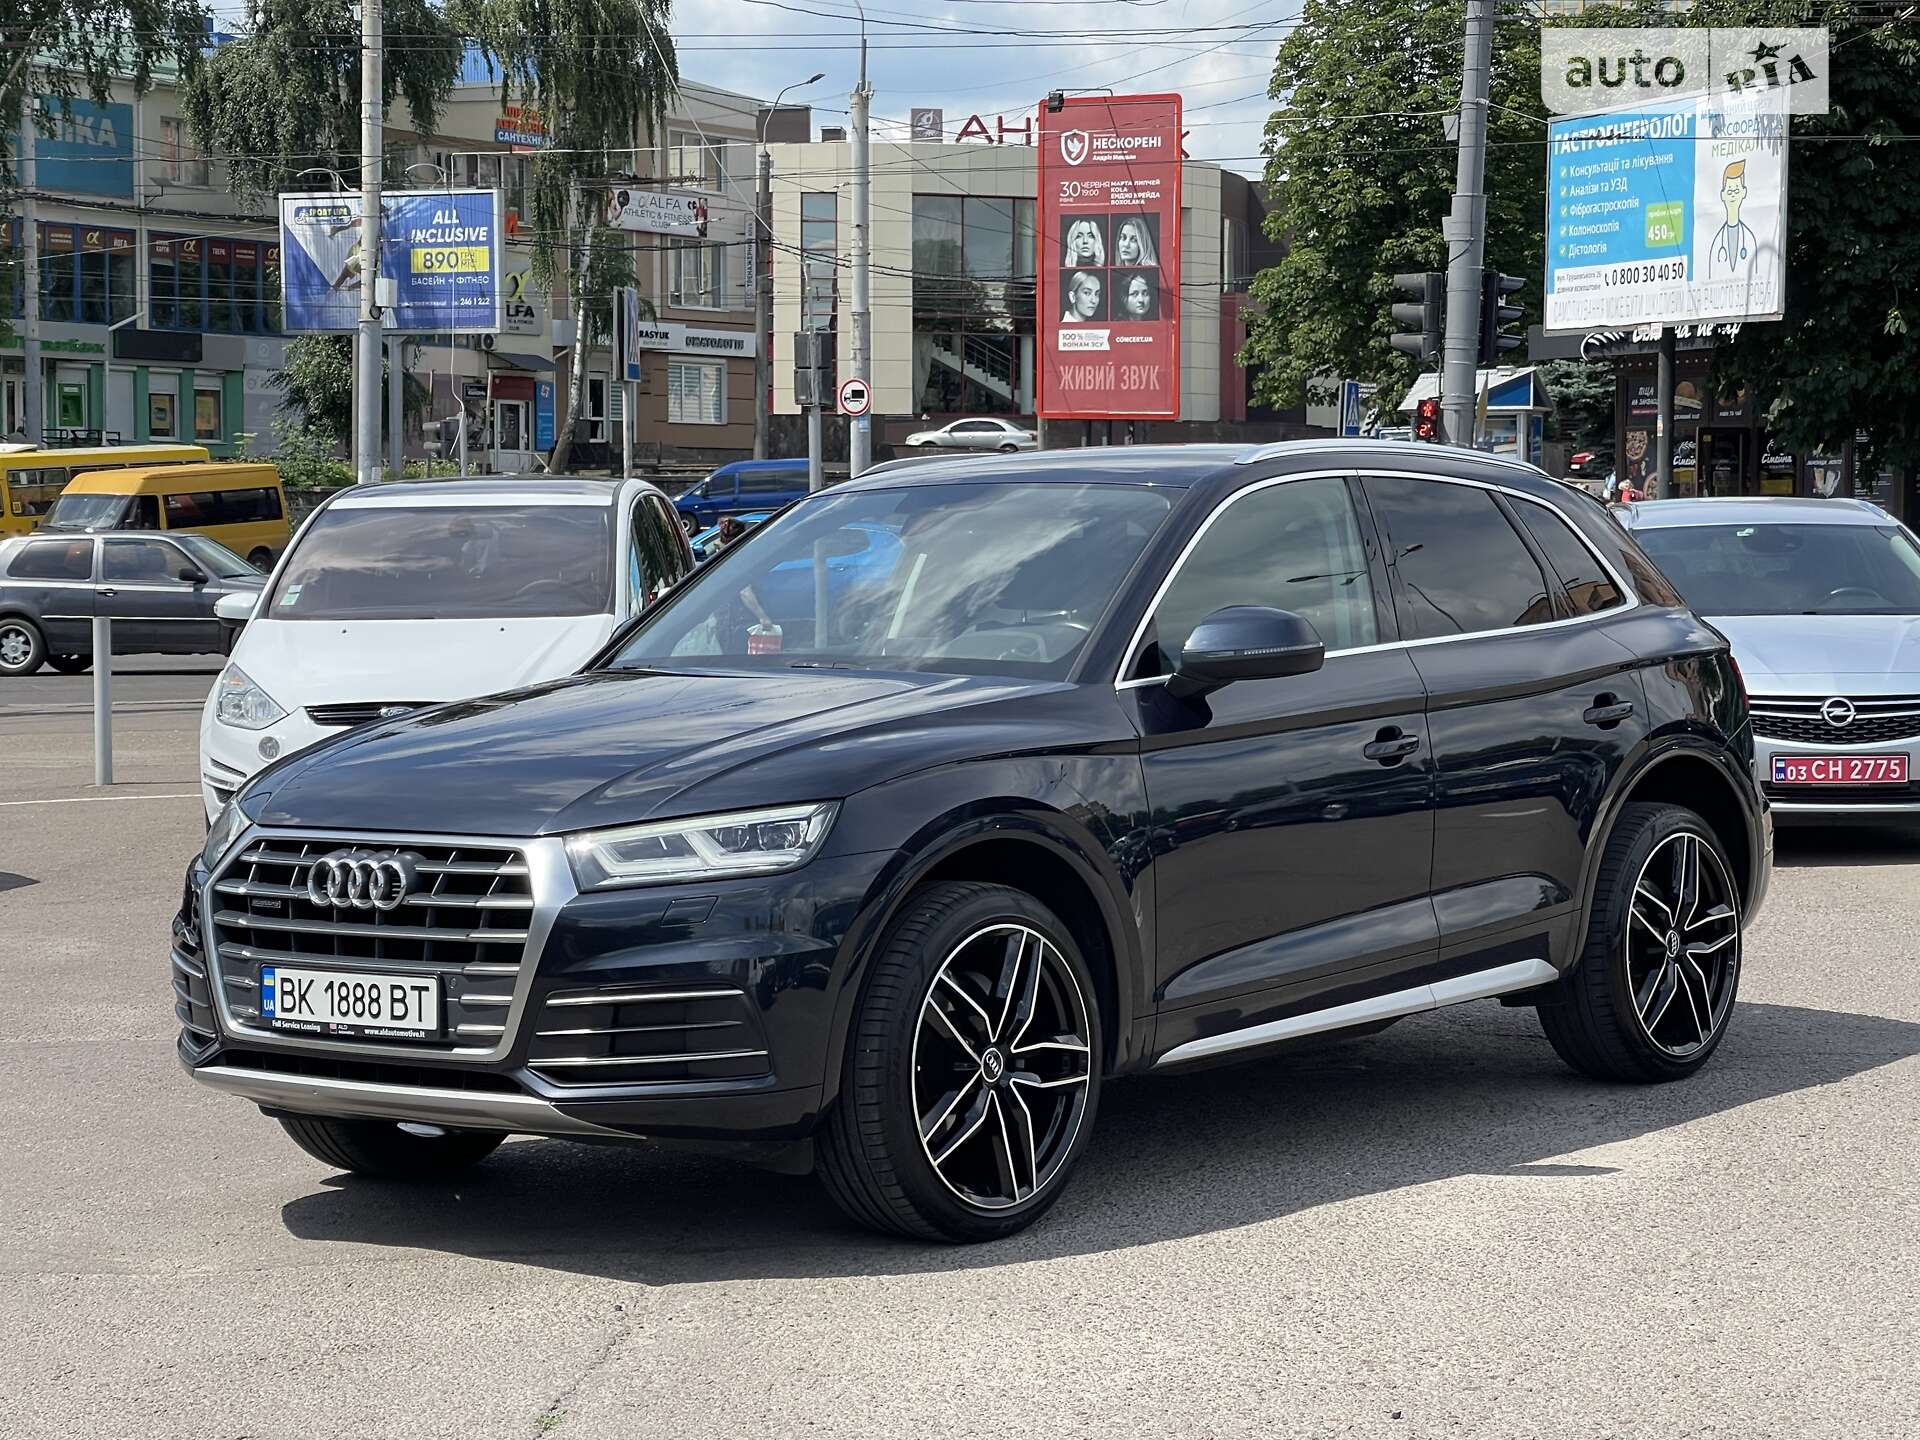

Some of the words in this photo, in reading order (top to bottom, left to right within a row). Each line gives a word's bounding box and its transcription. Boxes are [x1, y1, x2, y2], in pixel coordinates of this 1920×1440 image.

[1553, 111, 1693, 156] ГАСТРОЕНТЕРОЛОГ
[1093, 136, 1161, 149] НЕСКОРЕНІ
[1569, 159, 1620, 178] Консультації
[1622, 158, 1631, 170] та
[1632, 153, 1673, 170] лікування
[1060, 181, 1080, 196] 30
[1570, 182, 1599, 197] Аналізи
[1600, 182, 1609, 192] та
[1610, 177, 1628, 193] УЗД
[624, 207, 656, 219] ATHLETIC
[664, 213, 693, 223] FITNESS
[1570, 196, 1639, 217] Фіброгастроскопія
[432, 209, 460, 224] ALL
[411, 226, 488, 243] INCLUSIVE
[1569, 220, 1620, 237] Колоноскопія
[1647, 223, 1668, 241] 450
[1568, 241, 1608, 259] Дієтологія
[424, 251, 459, 269] 890
[411, 276, 445, 286] БАСЕЙН
[456, 275, 489, 284] ФІТНЕС
[1612, 269, 1618, 286] 0
[1620, 266, 1640, 285] 800
[1642, 264, 1656, 283] 30
[1658, 263, 1670, 281] 40
[1672, 261, 1684, 280] 50
[1059, 361, 1115, 391] ЖИВИЙ
[1120, 365, 1160, 391] ЗВУК
[1776, 772, 1785, 780] UA
[1787, 765, 1807, 781] 03
[1811, 760, 1842, 779] CH
[1850, 759, 1900, 779] 2775
[263, 999, 275, 1011] UA
[280, 977, 315, 1015] BK
[324, 980, 382, 1020] 1888
[389, 984, 430, 1023] BT
[281, 1021, 300, 1030] Service
[301, 1023, 321, 1033] Leasing
[364, 1028, 425, 1038] www.aldautomotive.lt
